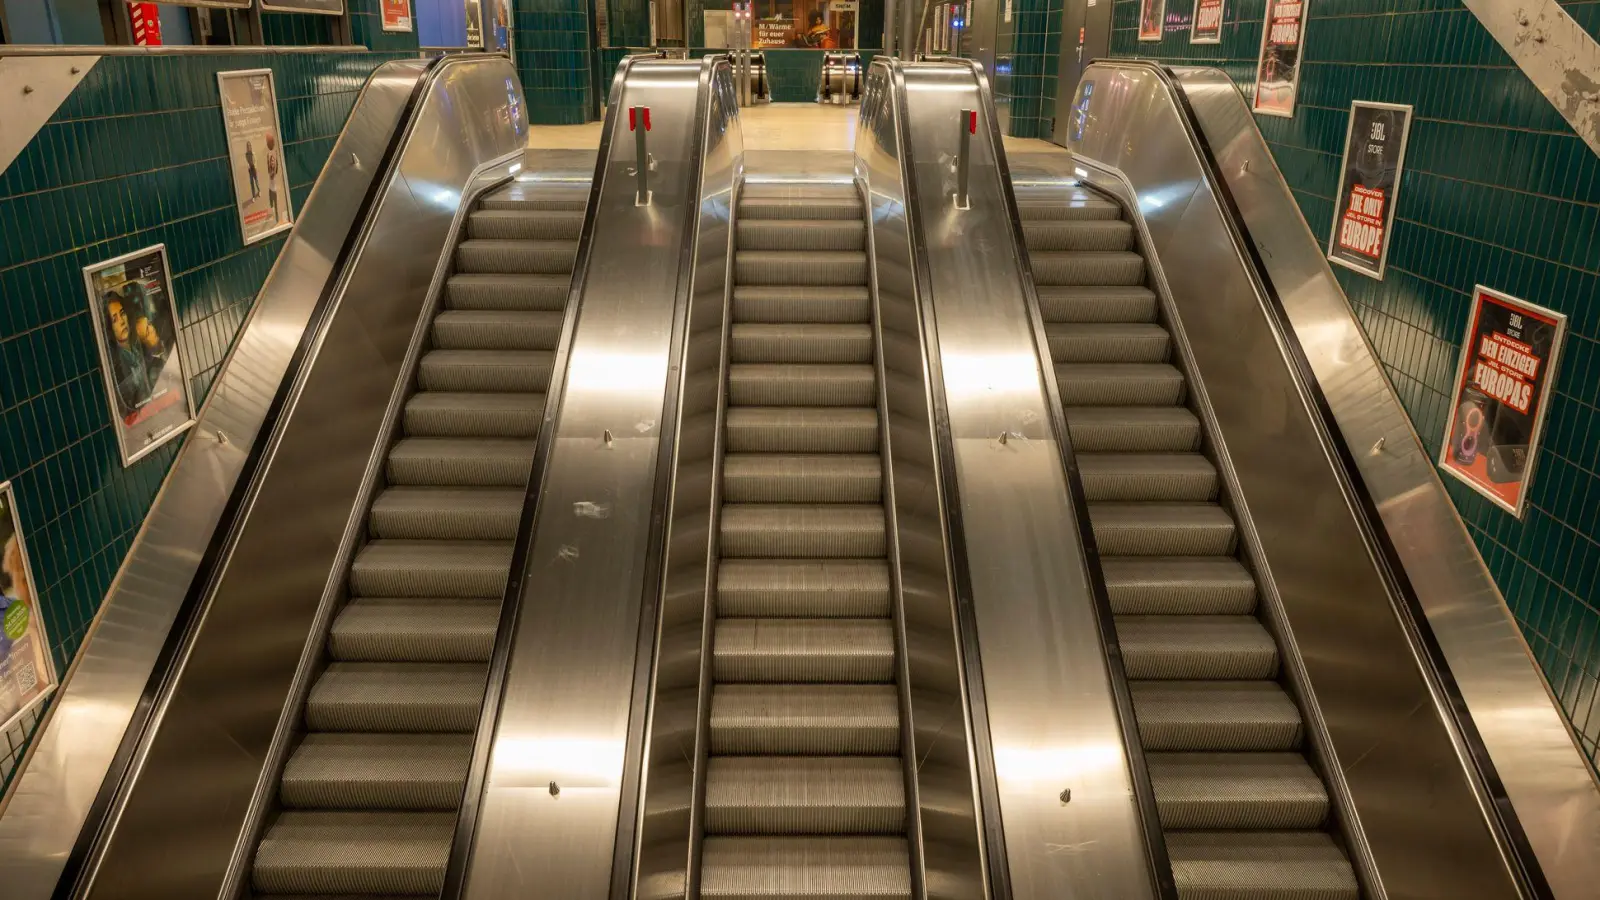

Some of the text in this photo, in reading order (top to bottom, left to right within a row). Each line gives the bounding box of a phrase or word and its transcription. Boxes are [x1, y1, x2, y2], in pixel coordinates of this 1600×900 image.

[1370, 122, 1386, 141] JBL
[1367, 144, 1384, 155] STORE
[1354, 186, 1383, 198] DISCOVER
[1350, 193, 1383, 218] THE ONLY
[1356, 214, 1376, 224] STORE
[1341, 217, 1383, 256] EUROPE
[1510, 313, 1523, 330] JBL
[1506, 328, 1521, 339] STORE
[1493, 334, 1531, 354] ENTDECKE
[1481, 337, 1538, 377] DEN EINZIGEN
[1500, 366, 1524, 380] STORE
[1474, 362, 1532, 412] EUROPAS
